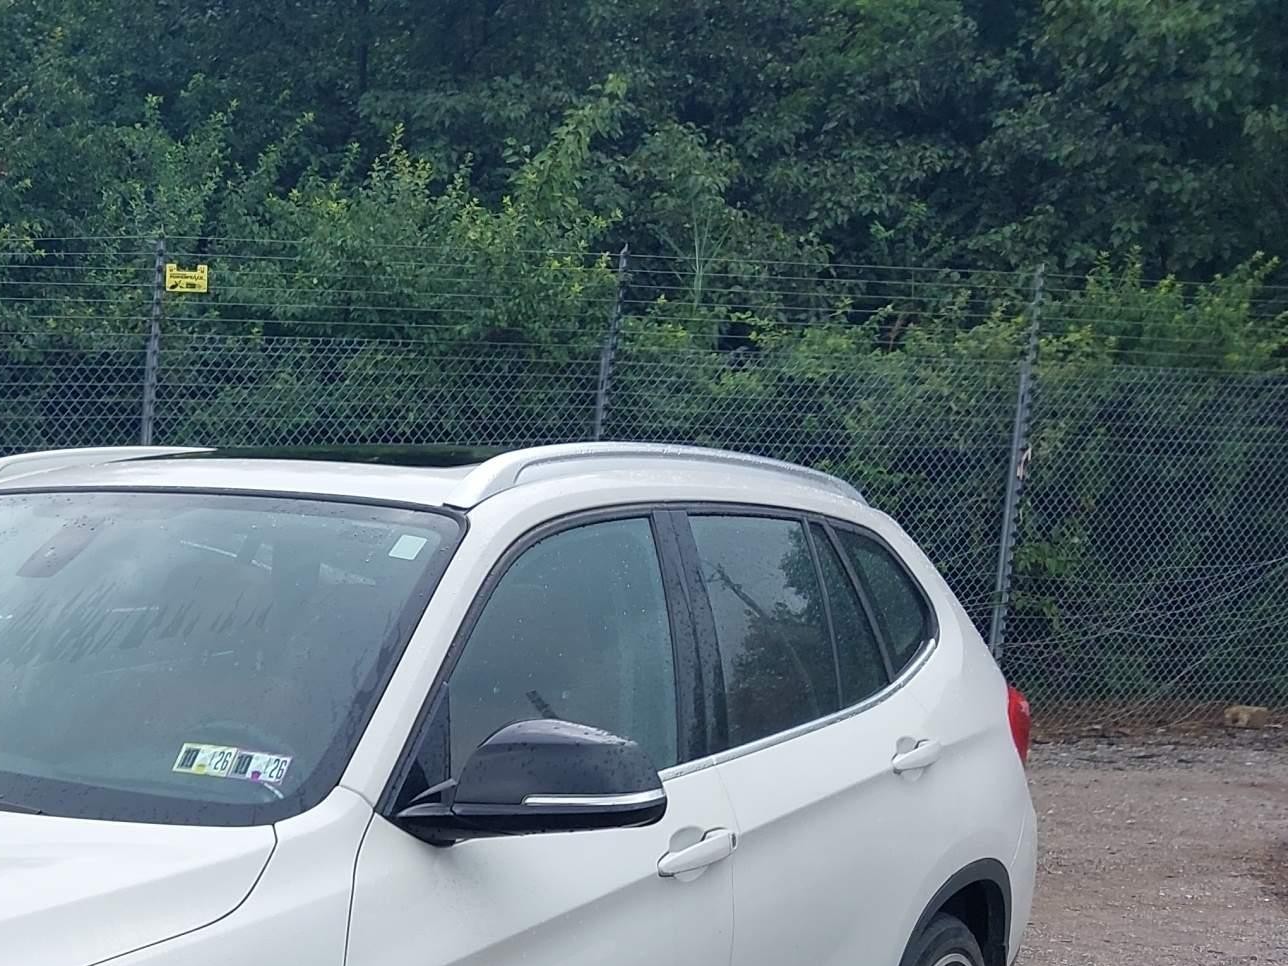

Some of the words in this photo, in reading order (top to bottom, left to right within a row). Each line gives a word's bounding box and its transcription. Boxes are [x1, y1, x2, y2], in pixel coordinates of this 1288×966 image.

[180, 747, 201, 769] 10
[213, 750, 233, 772] 26
[234, 754, 253, 775] 10
[268, 758, 288, 780] 26
